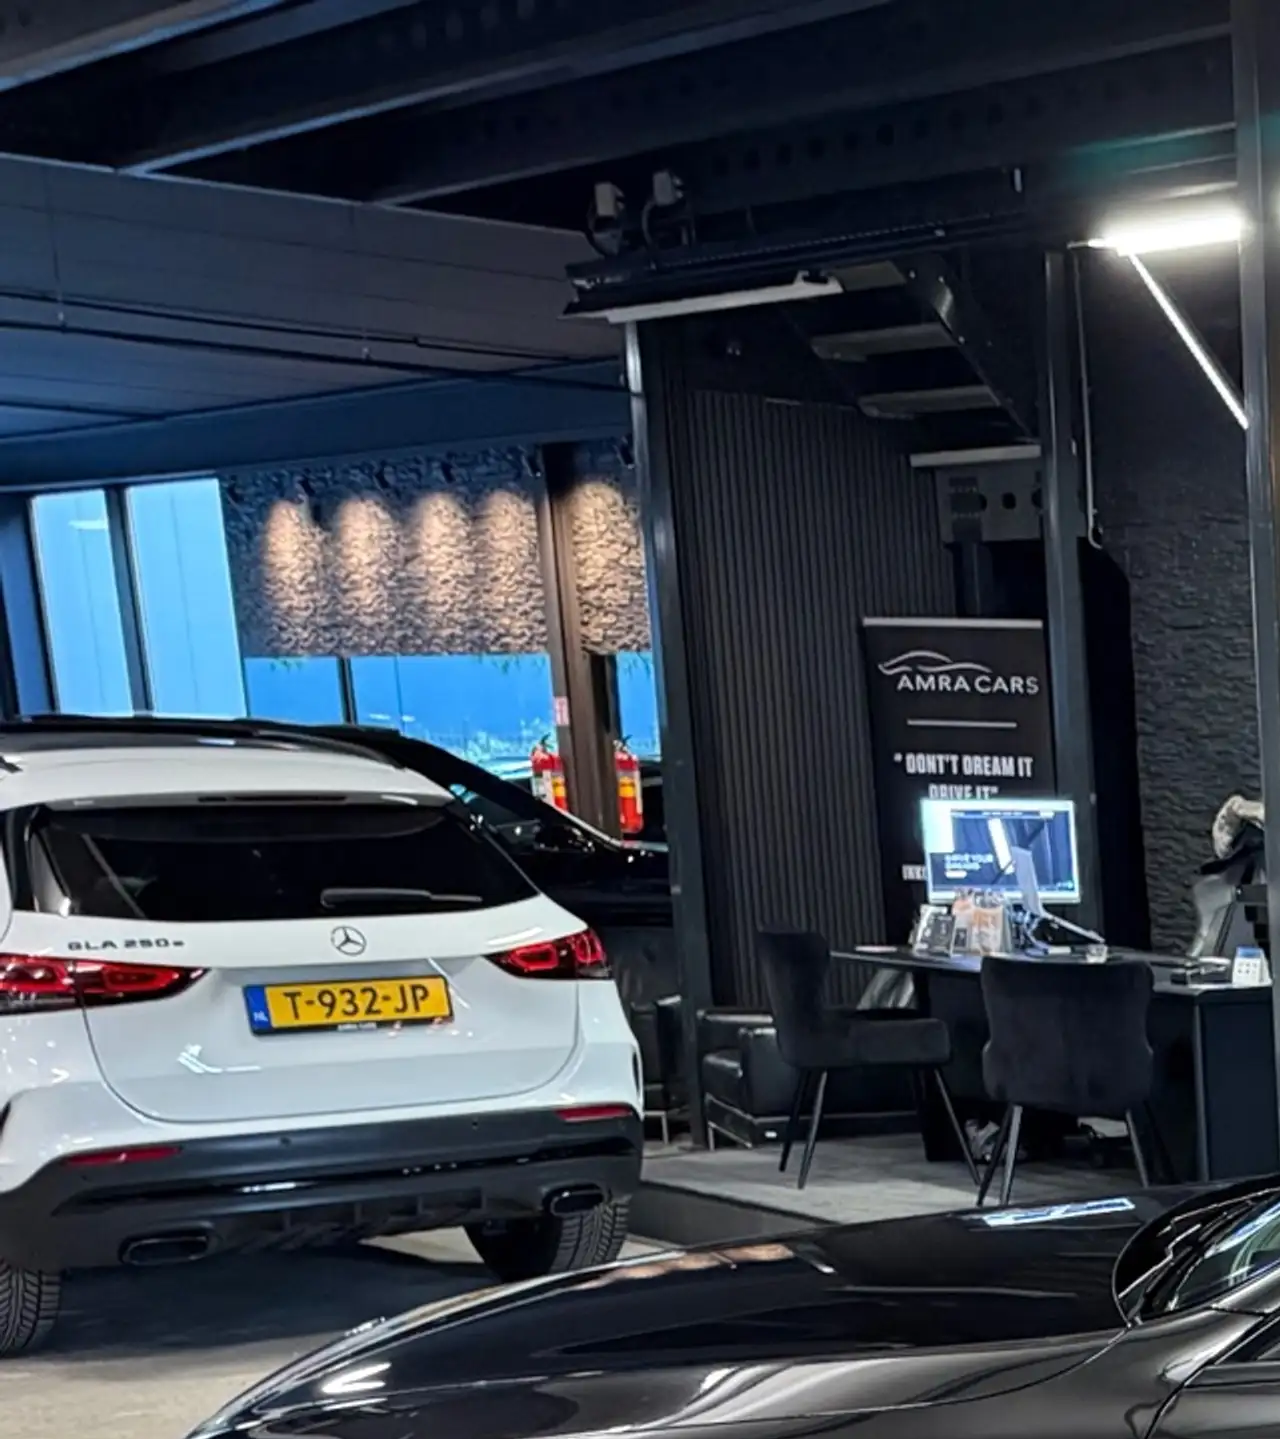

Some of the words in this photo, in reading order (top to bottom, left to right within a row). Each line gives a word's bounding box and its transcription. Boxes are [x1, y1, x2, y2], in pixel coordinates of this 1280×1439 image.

[897, 673, 971, 692] AMRA
[974, 674, 1040, 695] CARS
[962, 754, 1016, 777] DREAM
[1017, 756, 1034, 778] IT
[928, 783, 973, 799] DRIVE
[282, 983, 430, 1021] T-932-JP
